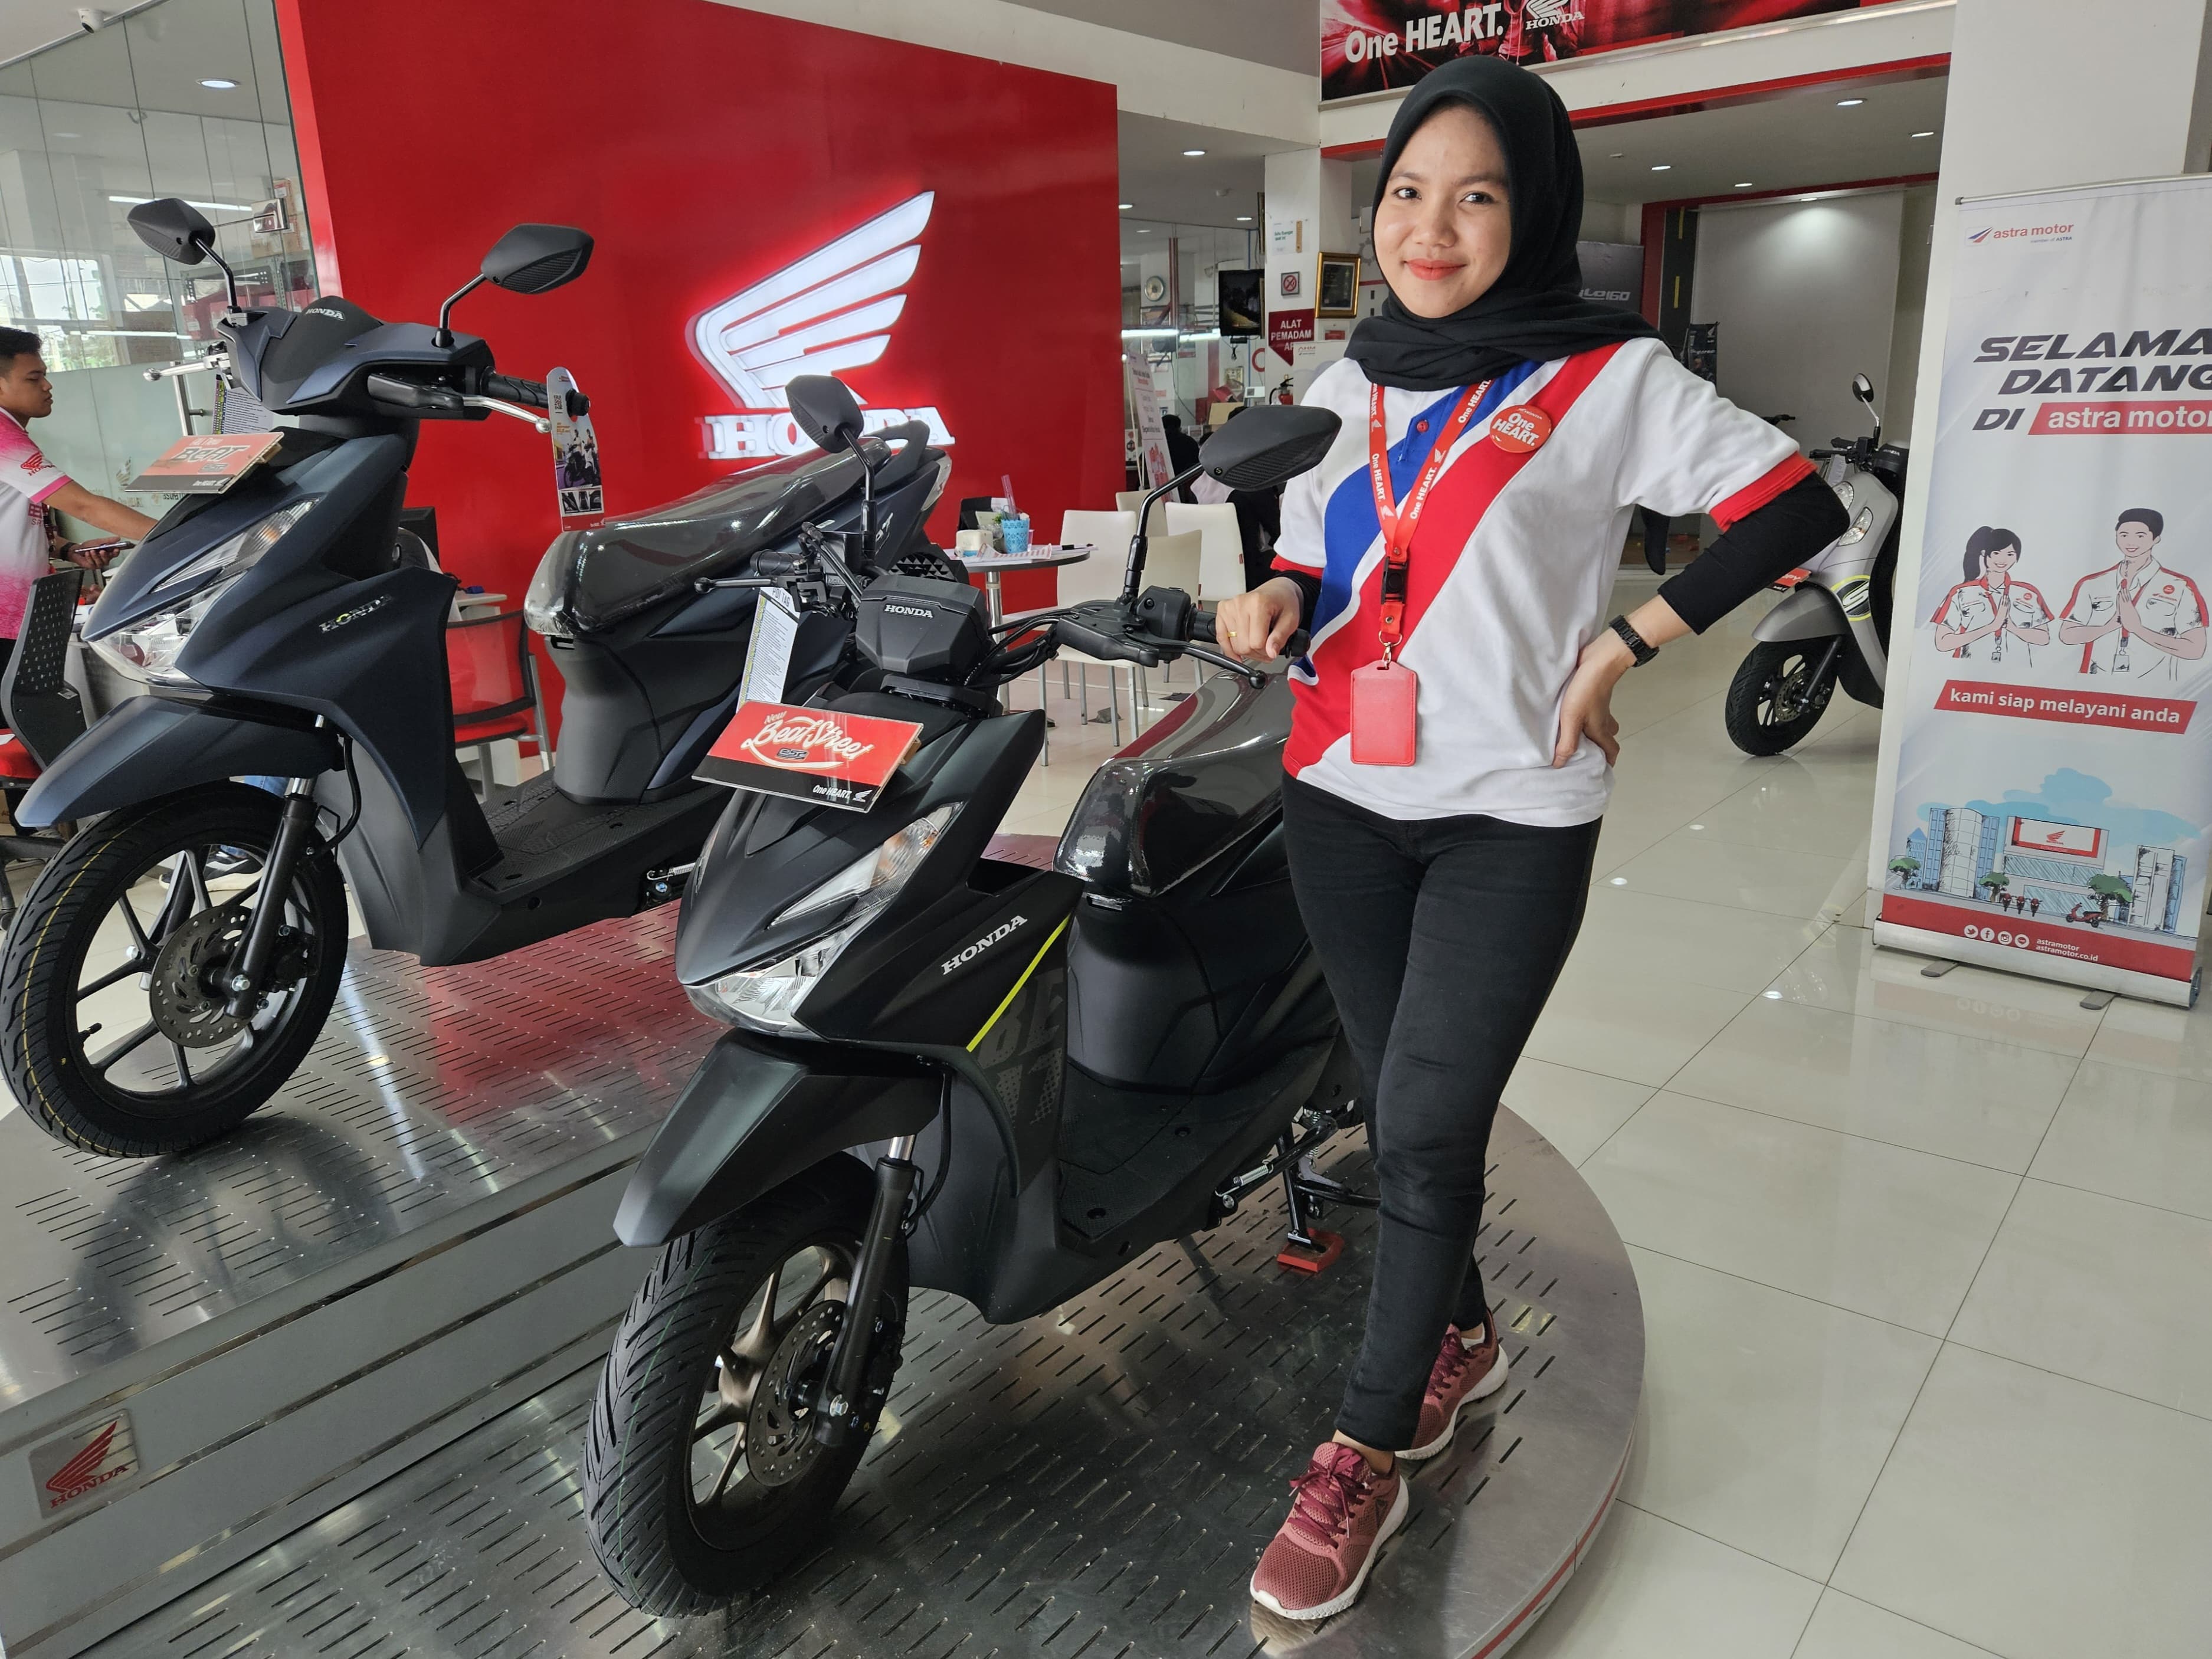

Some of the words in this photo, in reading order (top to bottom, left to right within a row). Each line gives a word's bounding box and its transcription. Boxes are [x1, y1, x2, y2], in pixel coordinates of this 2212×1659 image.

[1525, 11, 1585, 30] HONDA
[1345, 30, 1398, 63] One
[1405, 2, 1503, 53] HEART.
[1993, 228, 2028, 239] astra
[2031, 224, 2075, 235] motor
[306, 307, 343, 320] HONDA
[1280, 319, 1302, 329] ALAT
[1271, 330, 1312, 340] PEMADAM
[1997, 363, 2212, 395] DATANG
[1457, 407, 1473, 424] One
[1468, 379, 1492, 406] HEART.
[1508, 412, 1535, 431] One
[1972, 408, 2026, 431] DI
[2048, 407, 2120, 429] astra
[703, 406, 956, 460] HODA
[1492, 418, 1539, 447] HEART.
[1372, 453, 1380, 469] One
[1374, 470, 1387, 502] HEART.
[1410, 501, 1421, 520] One
[1416, 467, 1437, 502] HEART.
[781, 592, 791, 607] TAG
[884, 604, 933, 618] HONDA
[1950, 688, 1994, 705] kami
[1998, 694, 2035, 712] siap
[2039, 699, 2126, 718] melayani
[2131, 708, 2180, 723] anda
[764, 711, 787, 724] New
[741, 719, 824, 749] Beat
[802, 720, 875, 760] Street
[812, 785, 827, 795] One
[825, 786, 852, 799] HEART.
[941, 915, 1028, 975] HONDA
[2036, 939, 2080, 952] astramotor
[2036, 945, 2099, 962] astramotor.co.id
[50, 1464, 129, 1509] HONDA
